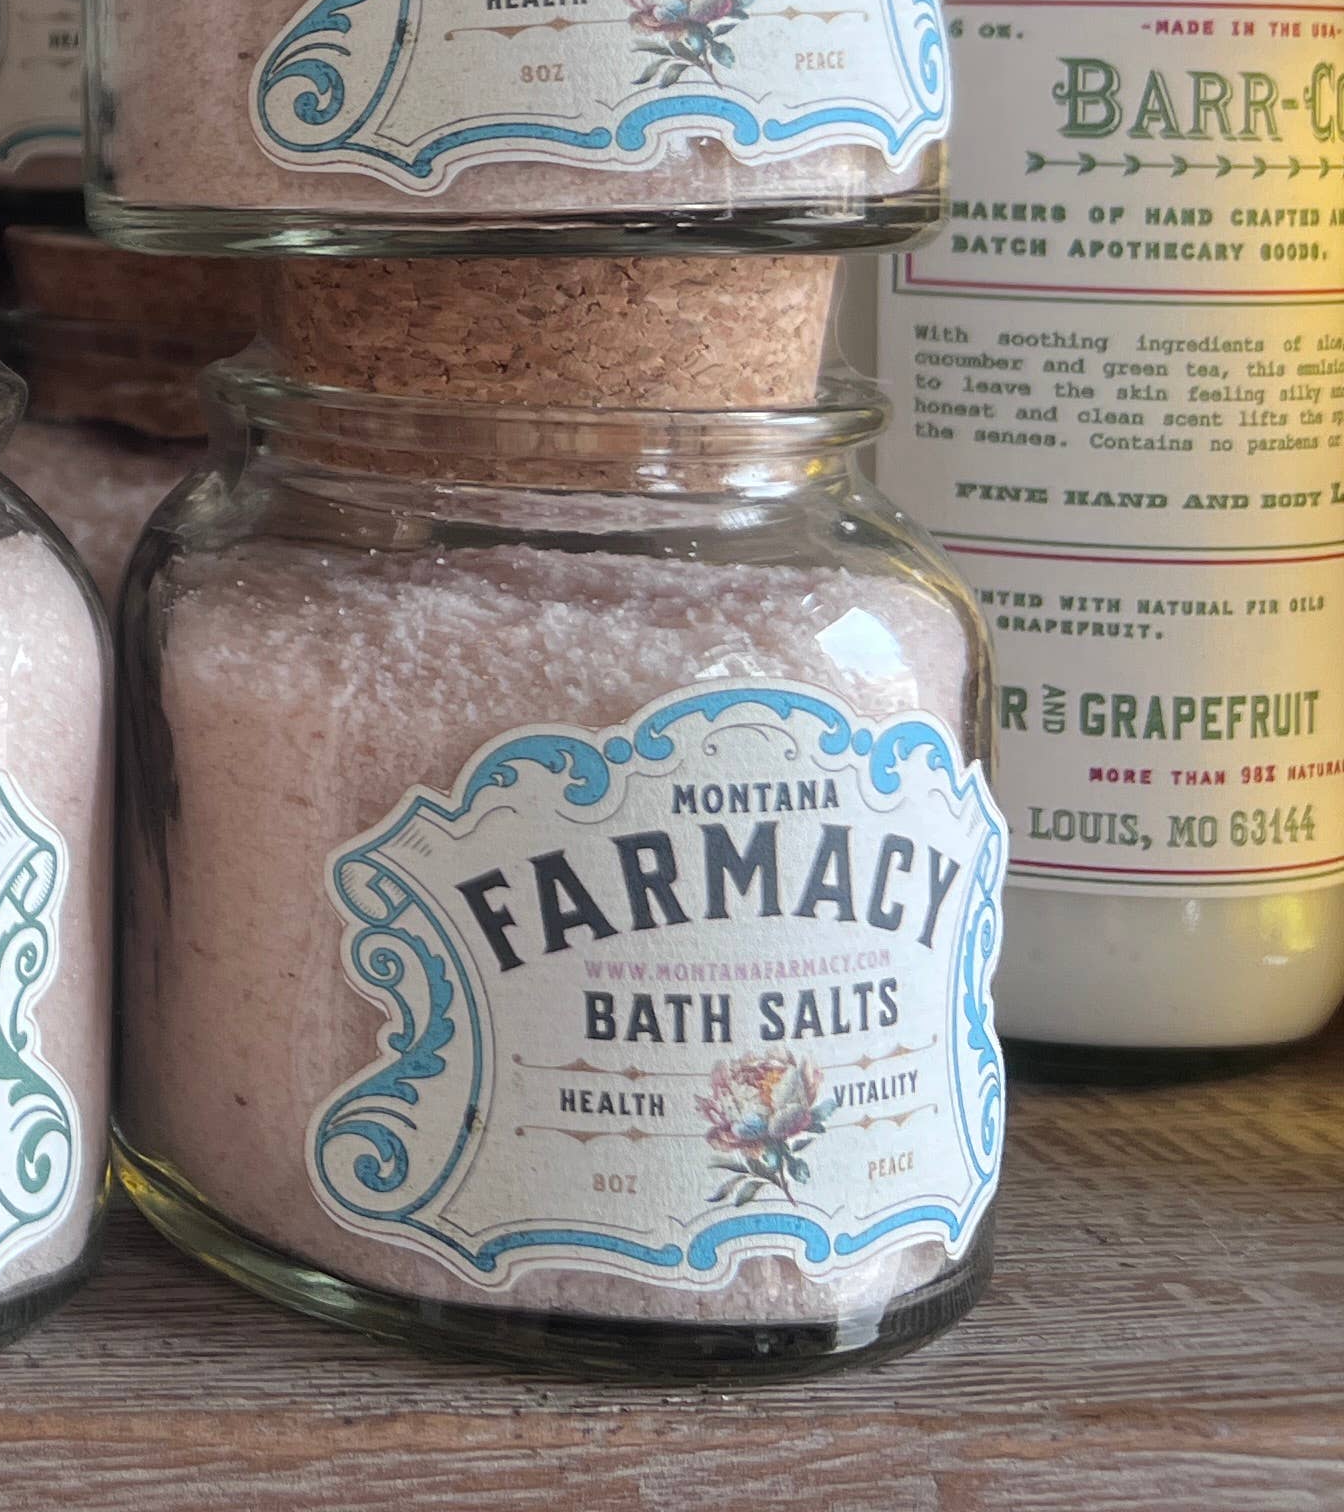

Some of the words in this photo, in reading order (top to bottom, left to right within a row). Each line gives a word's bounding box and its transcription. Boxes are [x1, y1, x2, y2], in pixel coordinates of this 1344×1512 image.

[1232, 21, 1255, 36] IN
[1269, 22, 1302, 37] THE
[795, 51, 845, 71] PEACE
[951, 200, 1067, 224] MAKERS
[1088, 206, 1125, 225] OF
[1145, 207, 1214, 226] HAND
[1230, 208, 1320, 227] CRAFTED
[951, 234, 1047, 257] BATCH
[1068, 239, 1244, 261] APOTHECARY
[913, 324, 969, 344] With
[997, 331, 1109, 353] soothing
[1136, 334, 1264, 355] ingredients
[1283, 335, 1301, 352] of
[914, 351, 1024, 371] cucumber
[1042, 357, 1085, 374] and
[1102, 361, 1169, 379] green
[1186, 362, 1229, 380] tea,
[1246, 361, 1285, 377] this
[915, 373, 942, 390] to
[962, 376, 1032, 396] leave
[1055, 382, 1095, 399] the
[1116, 385, 1168, 401] skin
[1188, 386, 1265, 405] feeling
[1279, 385, 1321, 404] silky
[914, 396, 995, 418] honest
[1015, 406, 1058, 423] and
[1077, 407, 1144, 426] clean
[1163, 411, 1223, 427] scent
[1239, 410, 1288, 427] lifts
[1300, 410, 1323, 425] the
[915, 421, 954, 440] the
[974, 429, 1067, 448] senses.
[1089, 433, 1193, 451] Contains
[1209, 437, 1233, 452] no
[1247, 435, 1318, 456] parabens
[955, 482, 1048, 504] FINE
[1064, 489, 1168, 509] HAND
[1182, 493, 1250, 510] AND
[1261, 491, 1322, 509] BODY
[976, 588, 1043, 609] NTED
[1060, 595, 1121, 614] WITH
[1137, 599, 1233, 616] NATURAL
[1246, 599, 1278, 616] FIR
[1289, 596, 1325, 613] OILS
[1042, 684, 1066, 735] AND
[1079, 690, 1319, 741] GRAPEFRUIT
[1089, 766, 1152, 785] MORE
[1171, 770, 1226, 786] THAN
[671, 779, 839, 815] MONTANA
[1027, 806, 1153, 851] LOUIS,
[1166, 814, 1218, 850] MO
[1230, 803, 1316, 848] 63144
[455, 821, 961, 973] FARMACY
[584, 949, 891, 982] WWW.MONTANAFARMACY.COM
[584, 990, 732, 1043] BATH
[759, 977, 899, 1041] SALTS
[559, 1088, 665, 1118] HEALTH
[833, 1070, 920, 1108] VITALITY
[867, 1152, 915, 1181] PEACE
